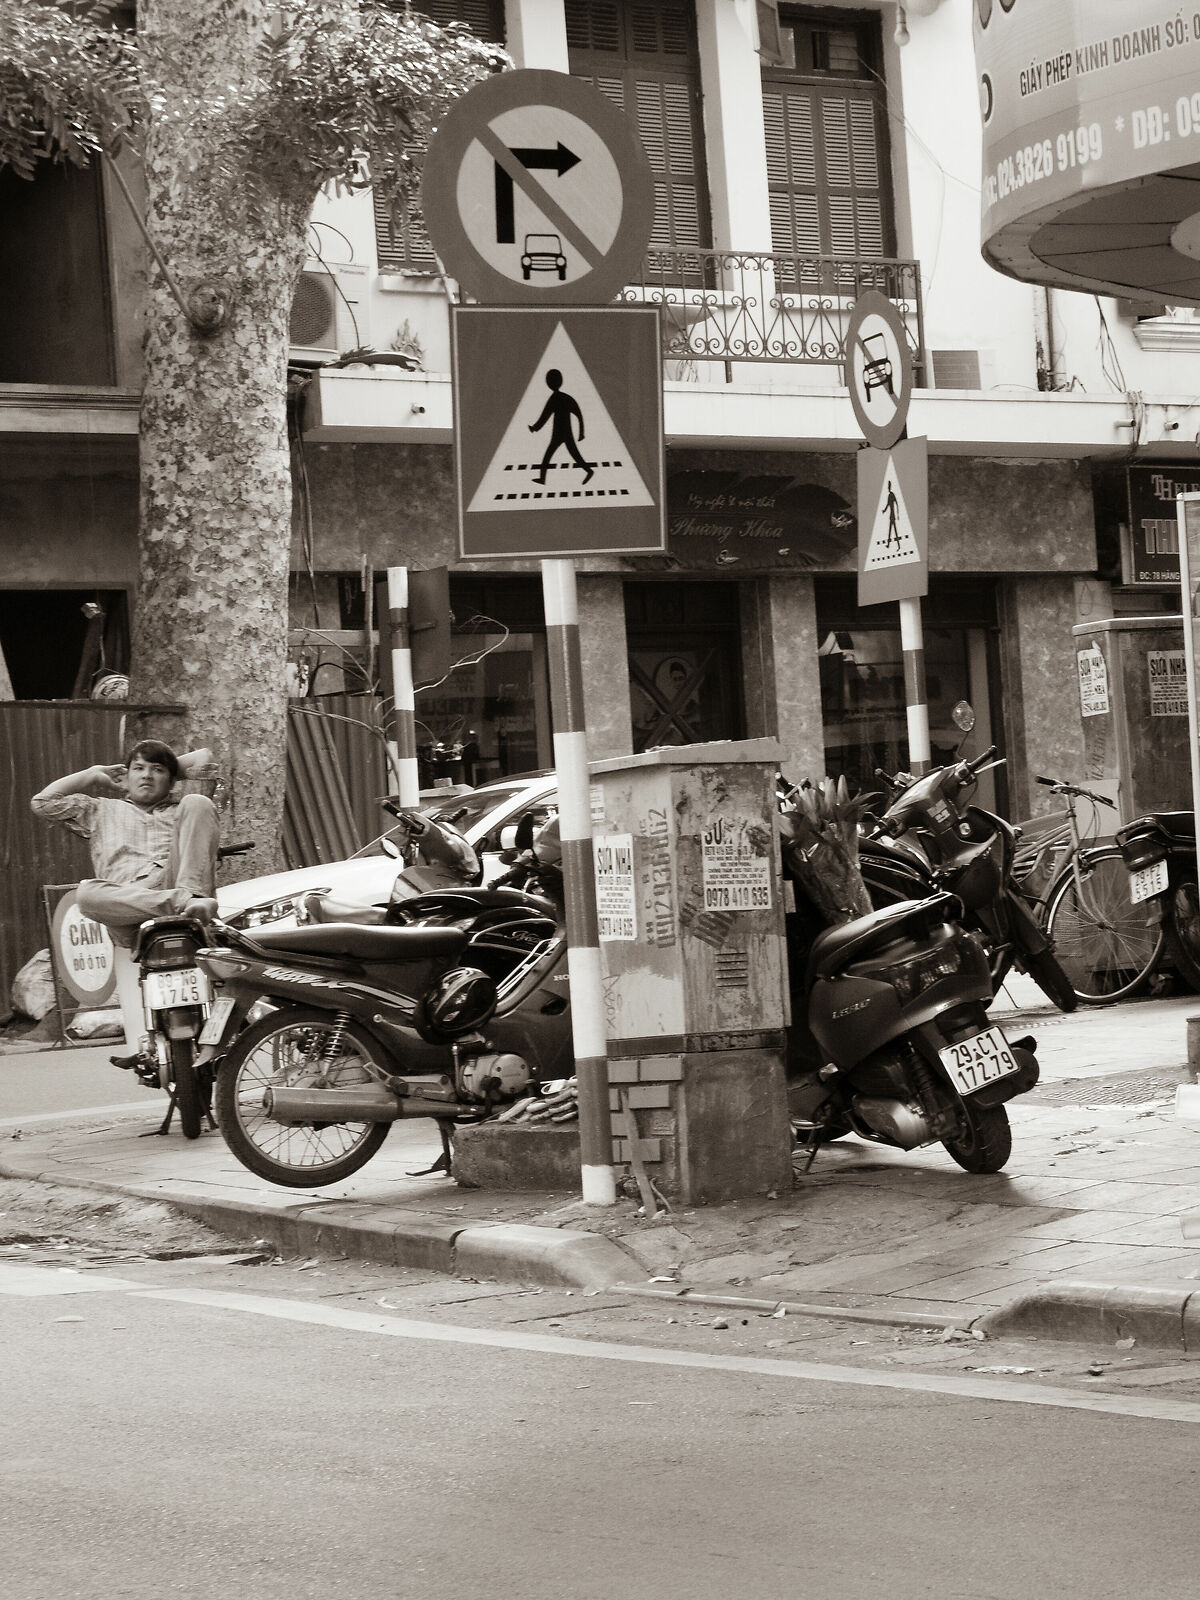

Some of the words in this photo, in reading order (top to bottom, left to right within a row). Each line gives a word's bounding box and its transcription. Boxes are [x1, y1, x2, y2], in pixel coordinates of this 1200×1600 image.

[1019, 57, 1043, 97] GIẤY
[1045, 50, 1072, 87] PHÉP
[1076, 40, 1109, 75] KINH
[1112, 25, 1161, 64] DOANH
[1165, 7, 1189, 48] SỐ:
[1056, 122, 1103, 172] 9199
[706, 887, 729, 907] 0978
[732, 887, 748, 906] 419
[958, 1051, 1014, 1089] 172.79
